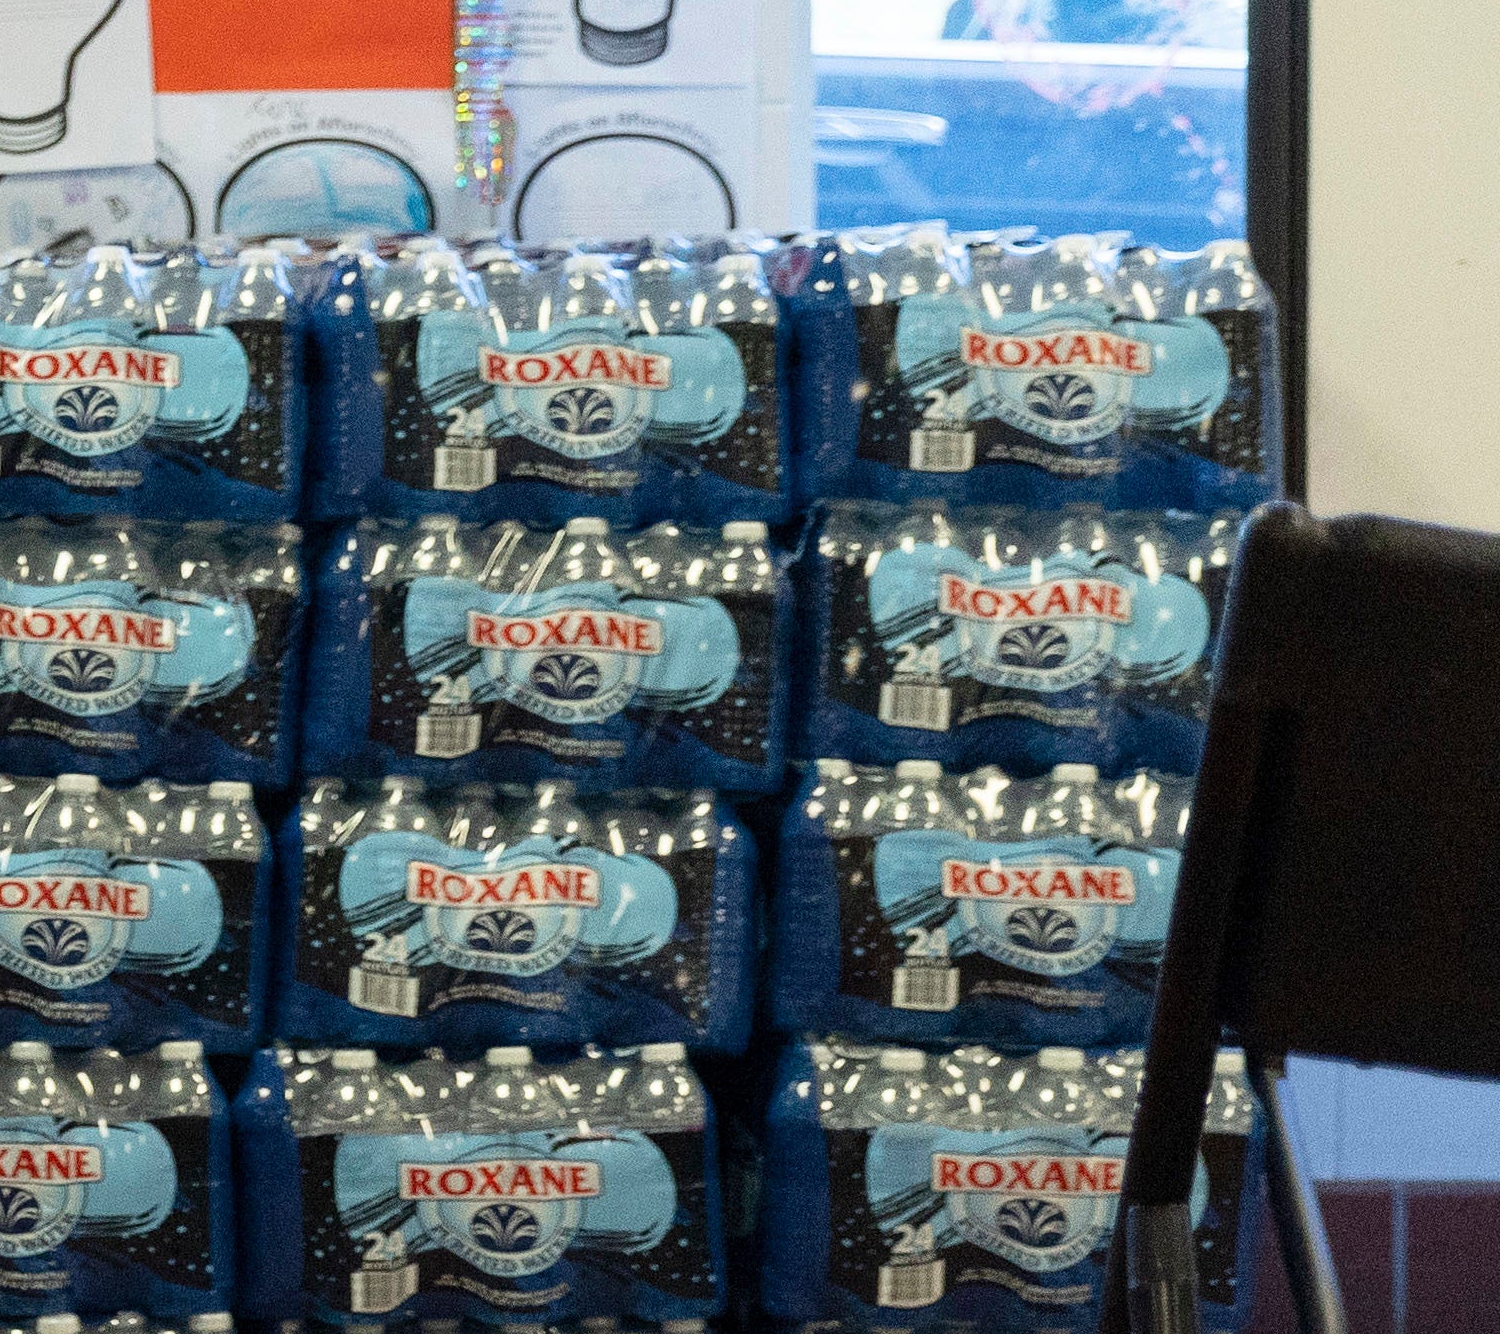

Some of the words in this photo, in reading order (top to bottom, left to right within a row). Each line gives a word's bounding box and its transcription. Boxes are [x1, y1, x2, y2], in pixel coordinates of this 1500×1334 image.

[487, 349, 662, 386] ROXANE
[967, 334, 1142, 371] ROXANE
[448, 408, 485, 435] 24
[948, 579, 1123, 618] ROXANE
[474, 615, 652, 651] ROXANE
[896, 645, 939, 672] 24
[432, 675, 470, 703] 24
[416, 865, 592, 904] ROXANE
[949, 863, 1128, 901] ROXANE
[365, 934, 408, 961] 24
[906, 928, 948, 955] 24
[408, 1164, 593, 1196] ROXANE
[939, 1158, 1120, 1192] ROXANE
[364, 1233, 407, 1260] 24
[894, 1224, 933, 1251] 24
